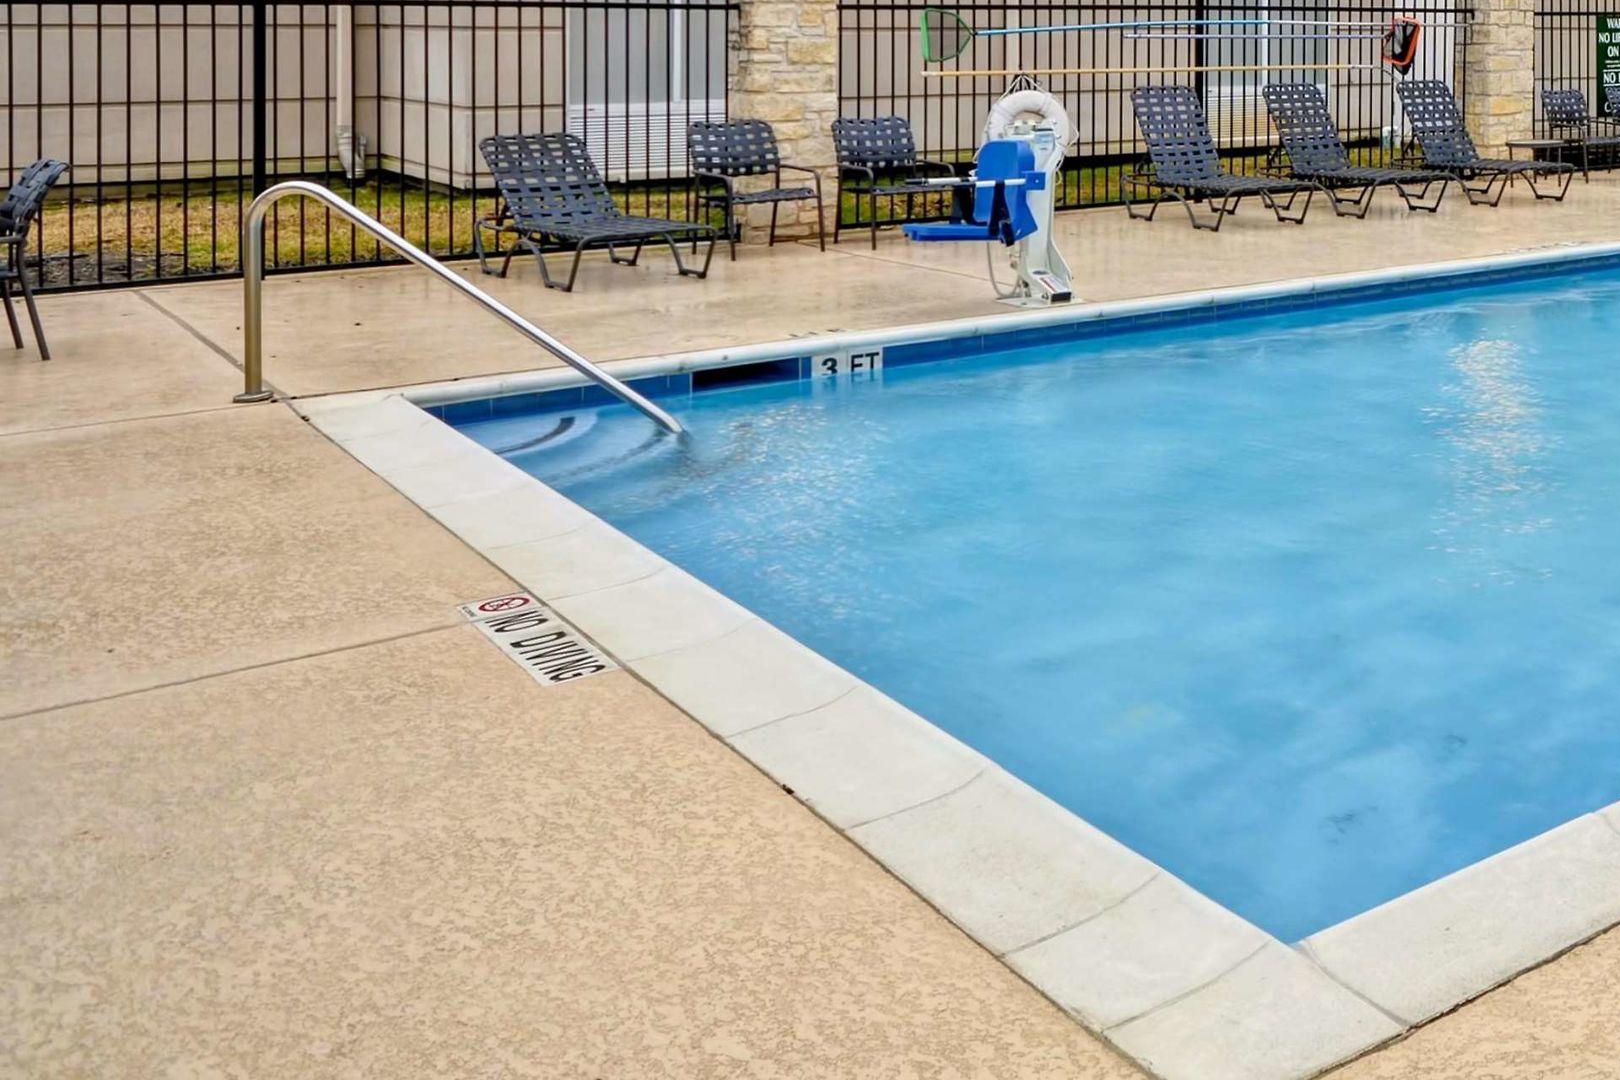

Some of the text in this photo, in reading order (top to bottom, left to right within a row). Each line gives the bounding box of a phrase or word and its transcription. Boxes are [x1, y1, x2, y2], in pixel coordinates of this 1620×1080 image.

[1598, 32, 1611, 43] NO
[1607, 45, 1620, 57] ON
[1603, 72, 1616, 83] NO
[821, 351, 880, 376] 3 FT
[484, 610, 606, 683] NO DIVING
